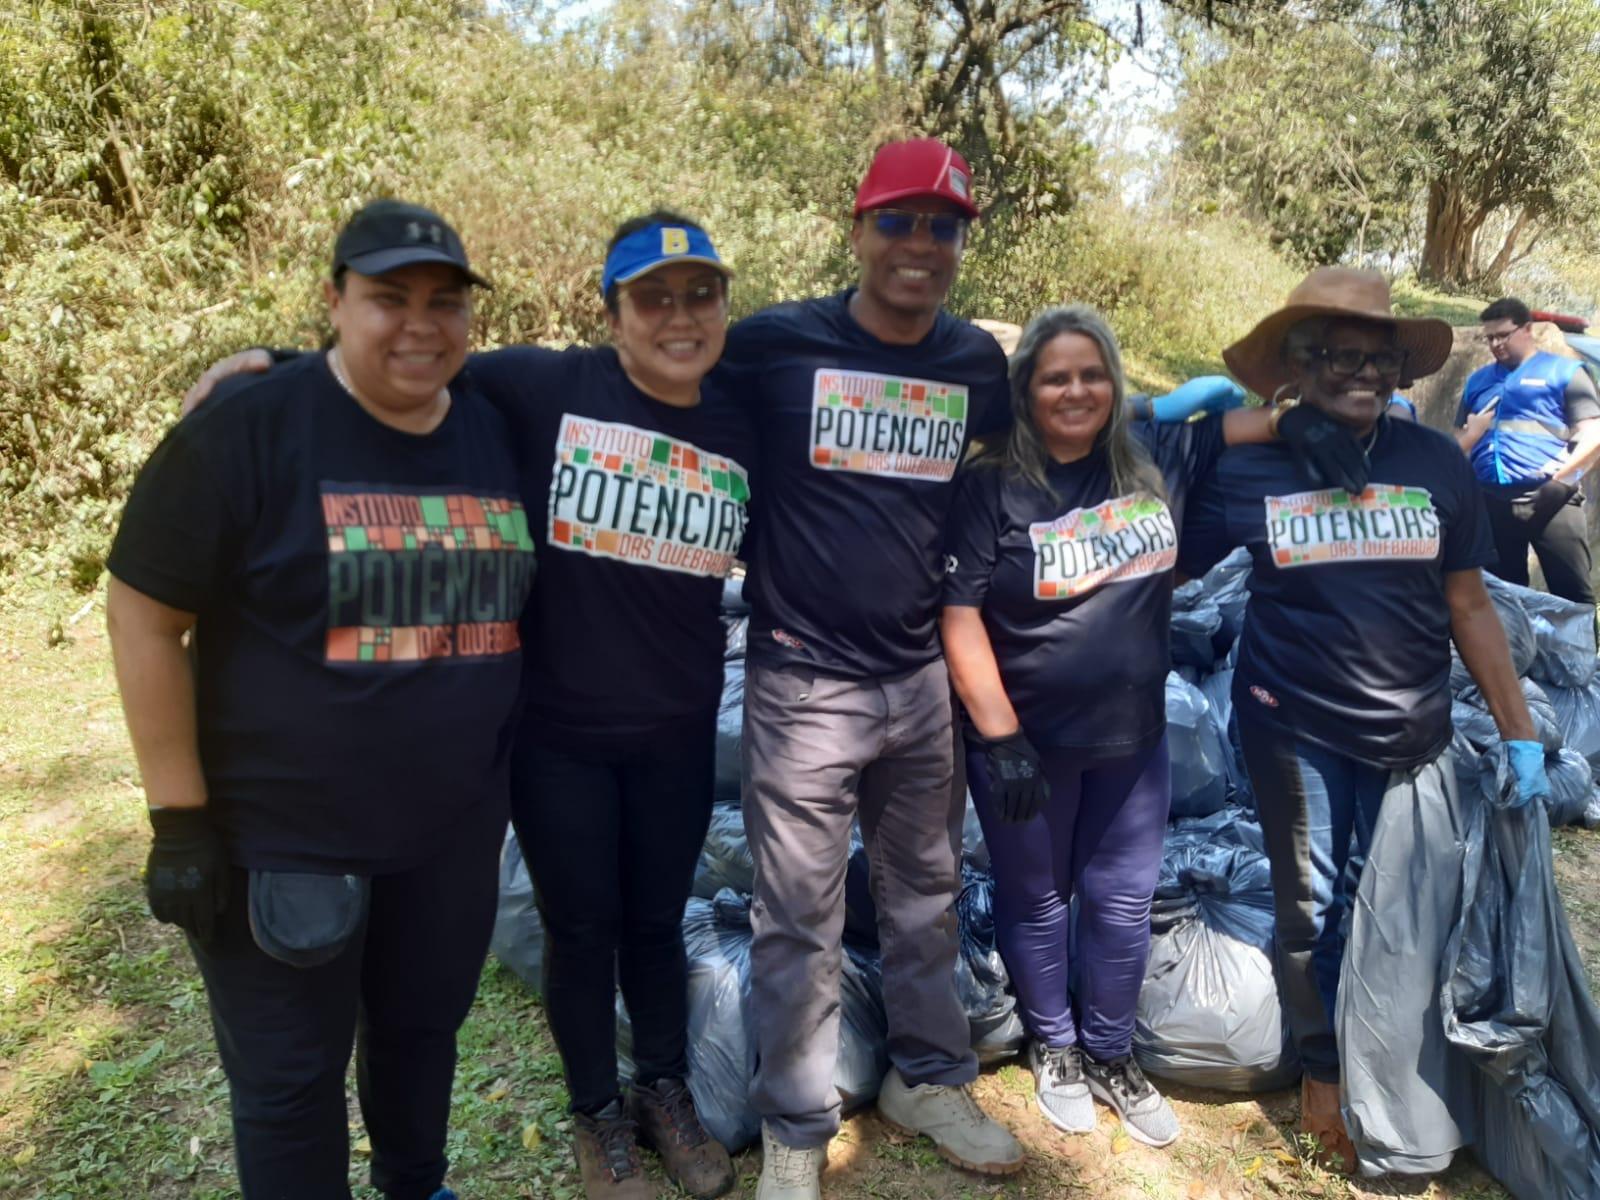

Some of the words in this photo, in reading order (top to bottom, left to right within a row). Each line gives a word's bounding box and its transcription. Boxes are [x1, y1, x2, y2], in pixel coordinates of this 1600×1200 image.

[661, 227, 689, 256] B
[819, 374, 885, 396] INSTITUTO
[564, 420, 650, 459] INSTITUTO
[815, 406, 963, 460] POTÊNCIAS
[322, 494, 424, 527] INSTITUTO
[618, 533, 655, 562] DAS
[1329, 541, 1357, 559] DAS
